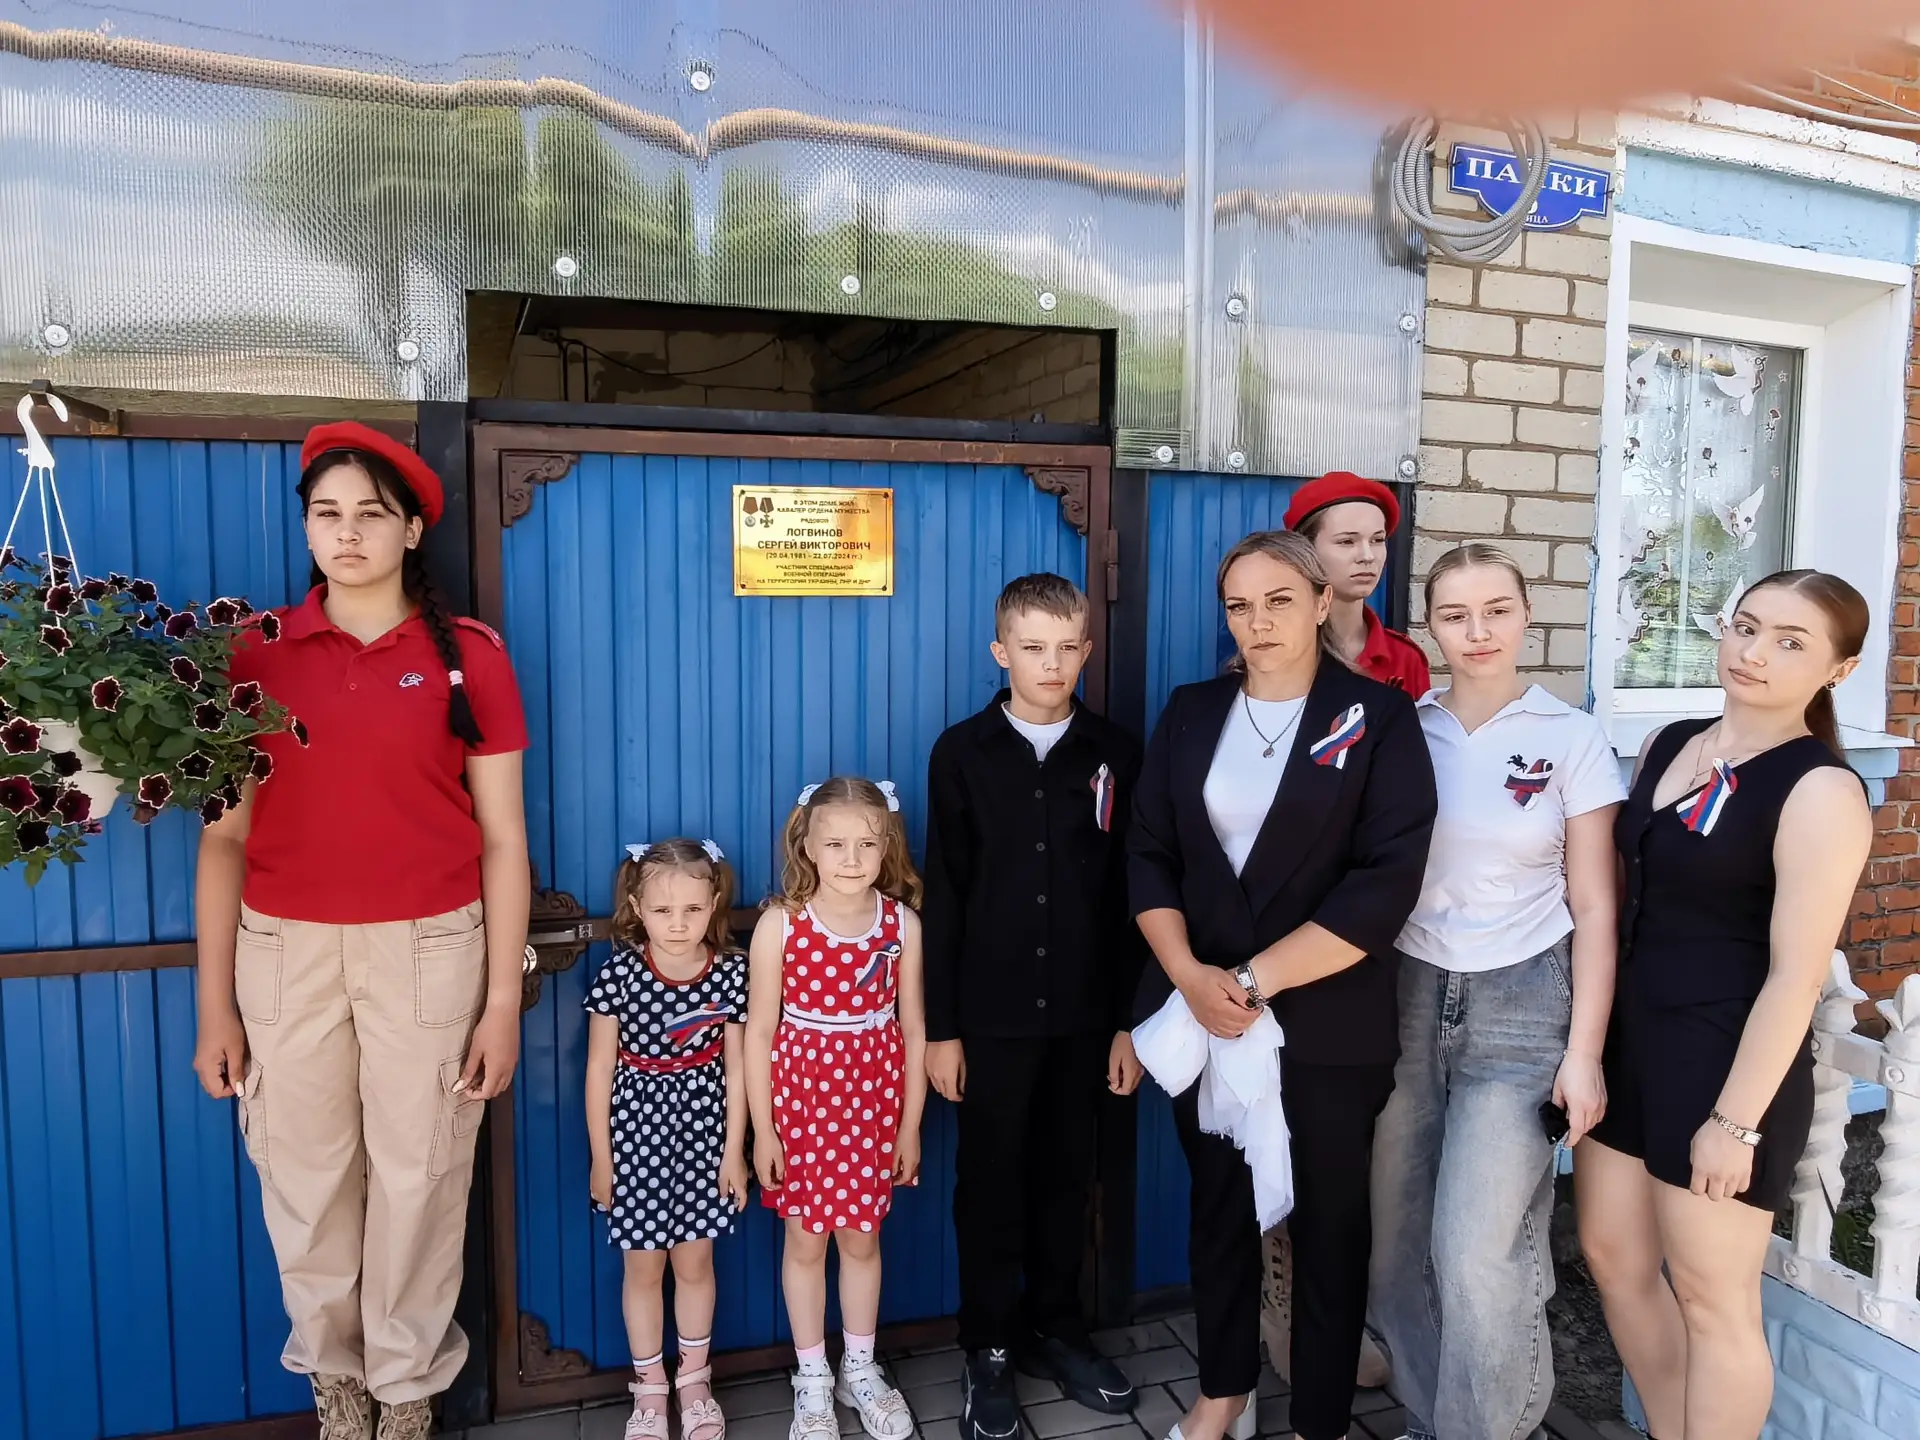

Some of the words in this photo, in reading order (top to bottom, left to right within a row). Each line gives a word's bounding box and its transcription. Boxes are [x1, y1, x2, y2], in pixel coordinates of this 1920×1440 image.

[1466, 157, 1598, 199] ПАКИ
[786, 528, 843, 537] ЛОГВИНОВ
[757, 539, 797, 550] СЕРГЕЙ
[799, 541, 871, 550] ВИКТОРОВИЧ
